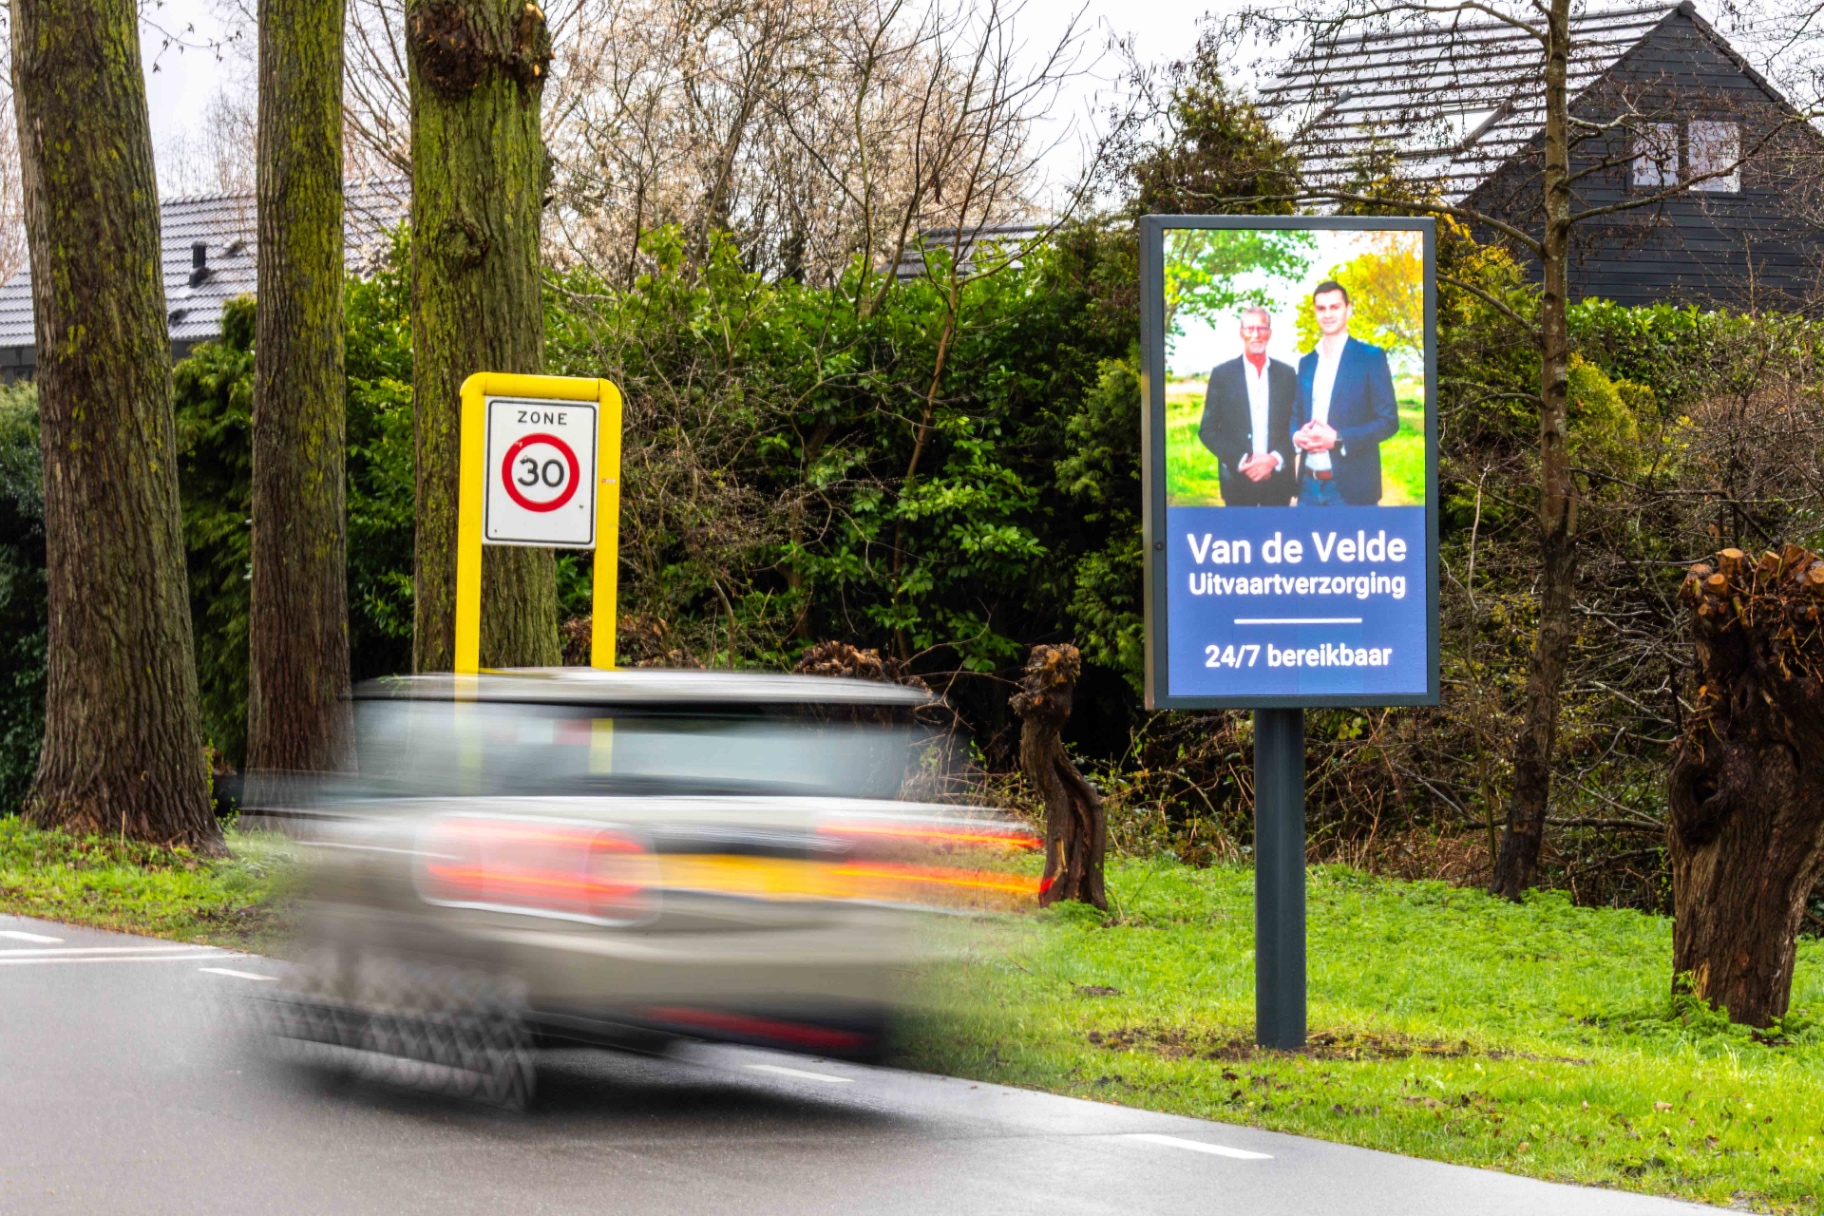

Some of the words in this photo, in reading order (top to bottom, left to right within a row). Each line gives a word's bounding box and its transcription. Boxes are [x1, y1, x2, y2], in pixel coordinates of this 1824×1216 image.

[517, 410, 567, 425] ZONE
[517, 457, 565, 488] 30
[1187, 533, 1251, 564] Van
[1262, 532, 1303, 564] de
[1312, 530, 1407, 562] Velde
[1189, 571, 1406, 599] Uitvaartverzorging
[1205, 645, 1261, 668] 24/7
[1268, 643, 1392, 667] bereikbaar
